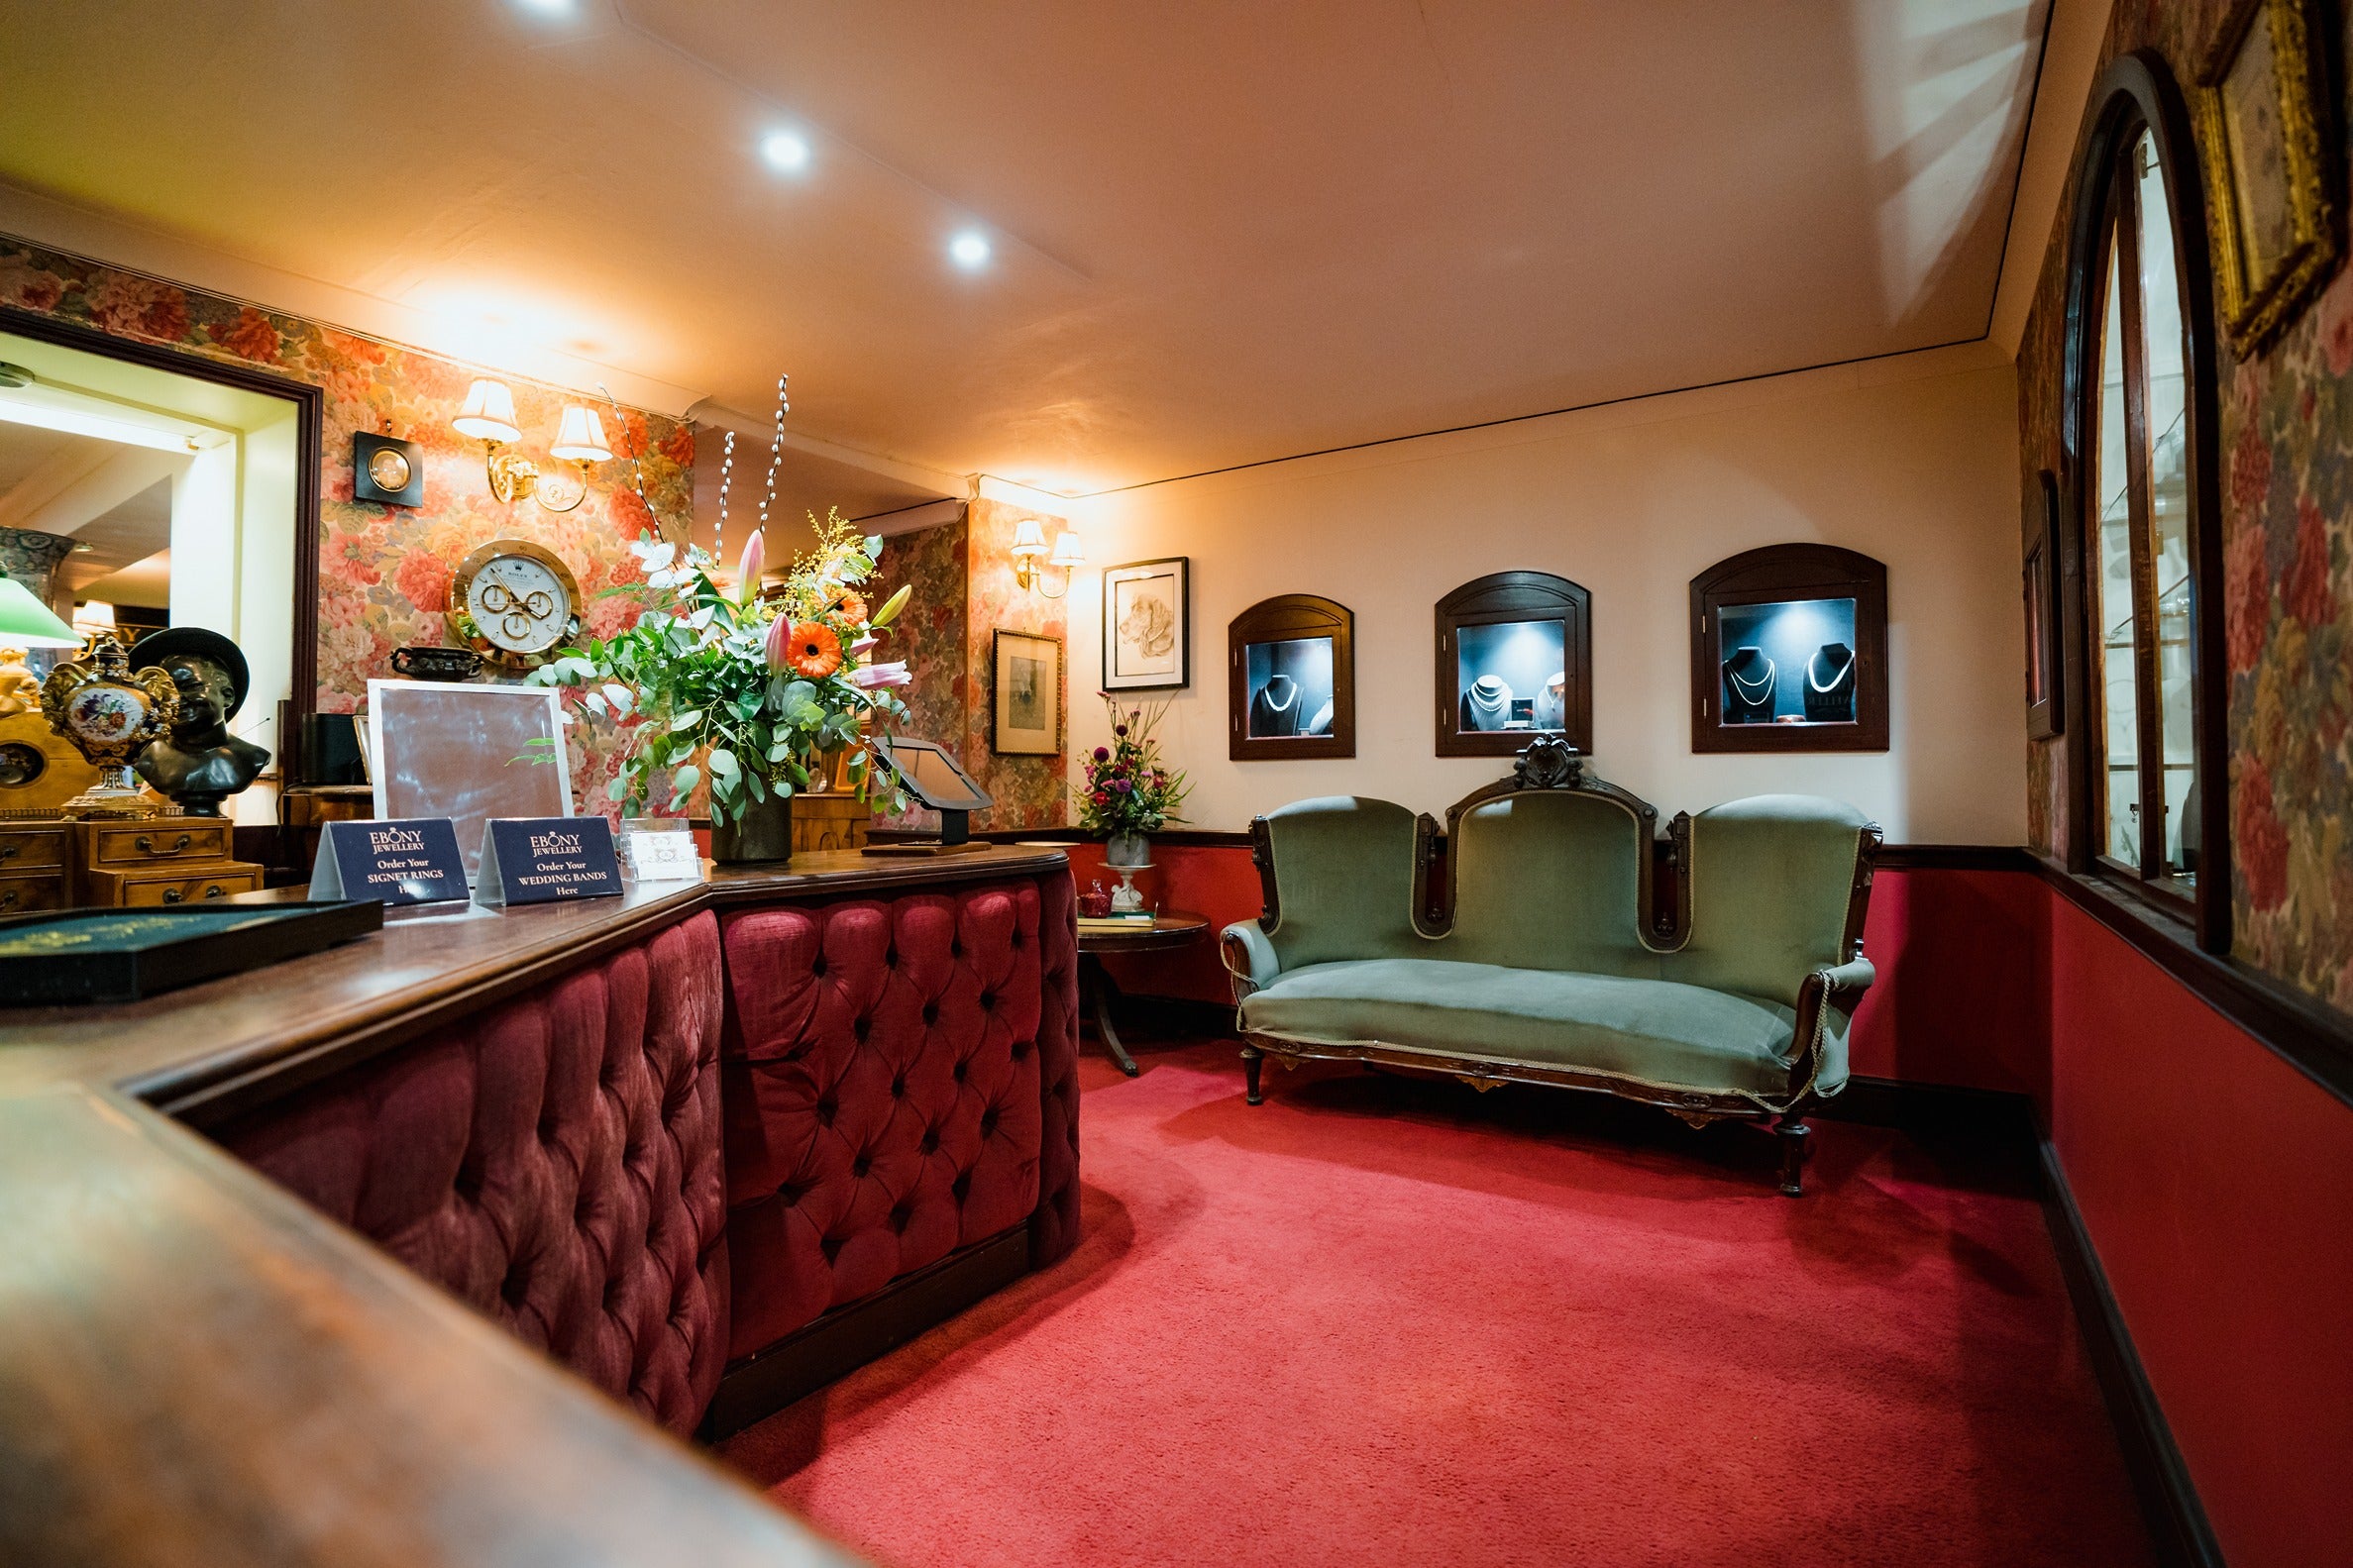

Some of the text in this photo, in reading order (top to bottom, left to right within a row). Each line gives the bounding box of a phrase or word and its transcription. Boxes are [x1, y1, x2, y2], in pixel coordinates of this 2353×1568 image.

[369, 827, 422, 845] EBONY
[529, 831, 581, 848] EBONY
[373, 842, 425, 855] JEWELLERY
[532, 845, 583, 858] JEWELLERY
[376, 858, 430, 870] Order Your
[536, 861, 587, 872] Order Your
[367, 869, 445, 884] SIGNET RINGS
[518, 871, 607, 886] WEDDING BANDS
[556, 887, 579, 895] Here
